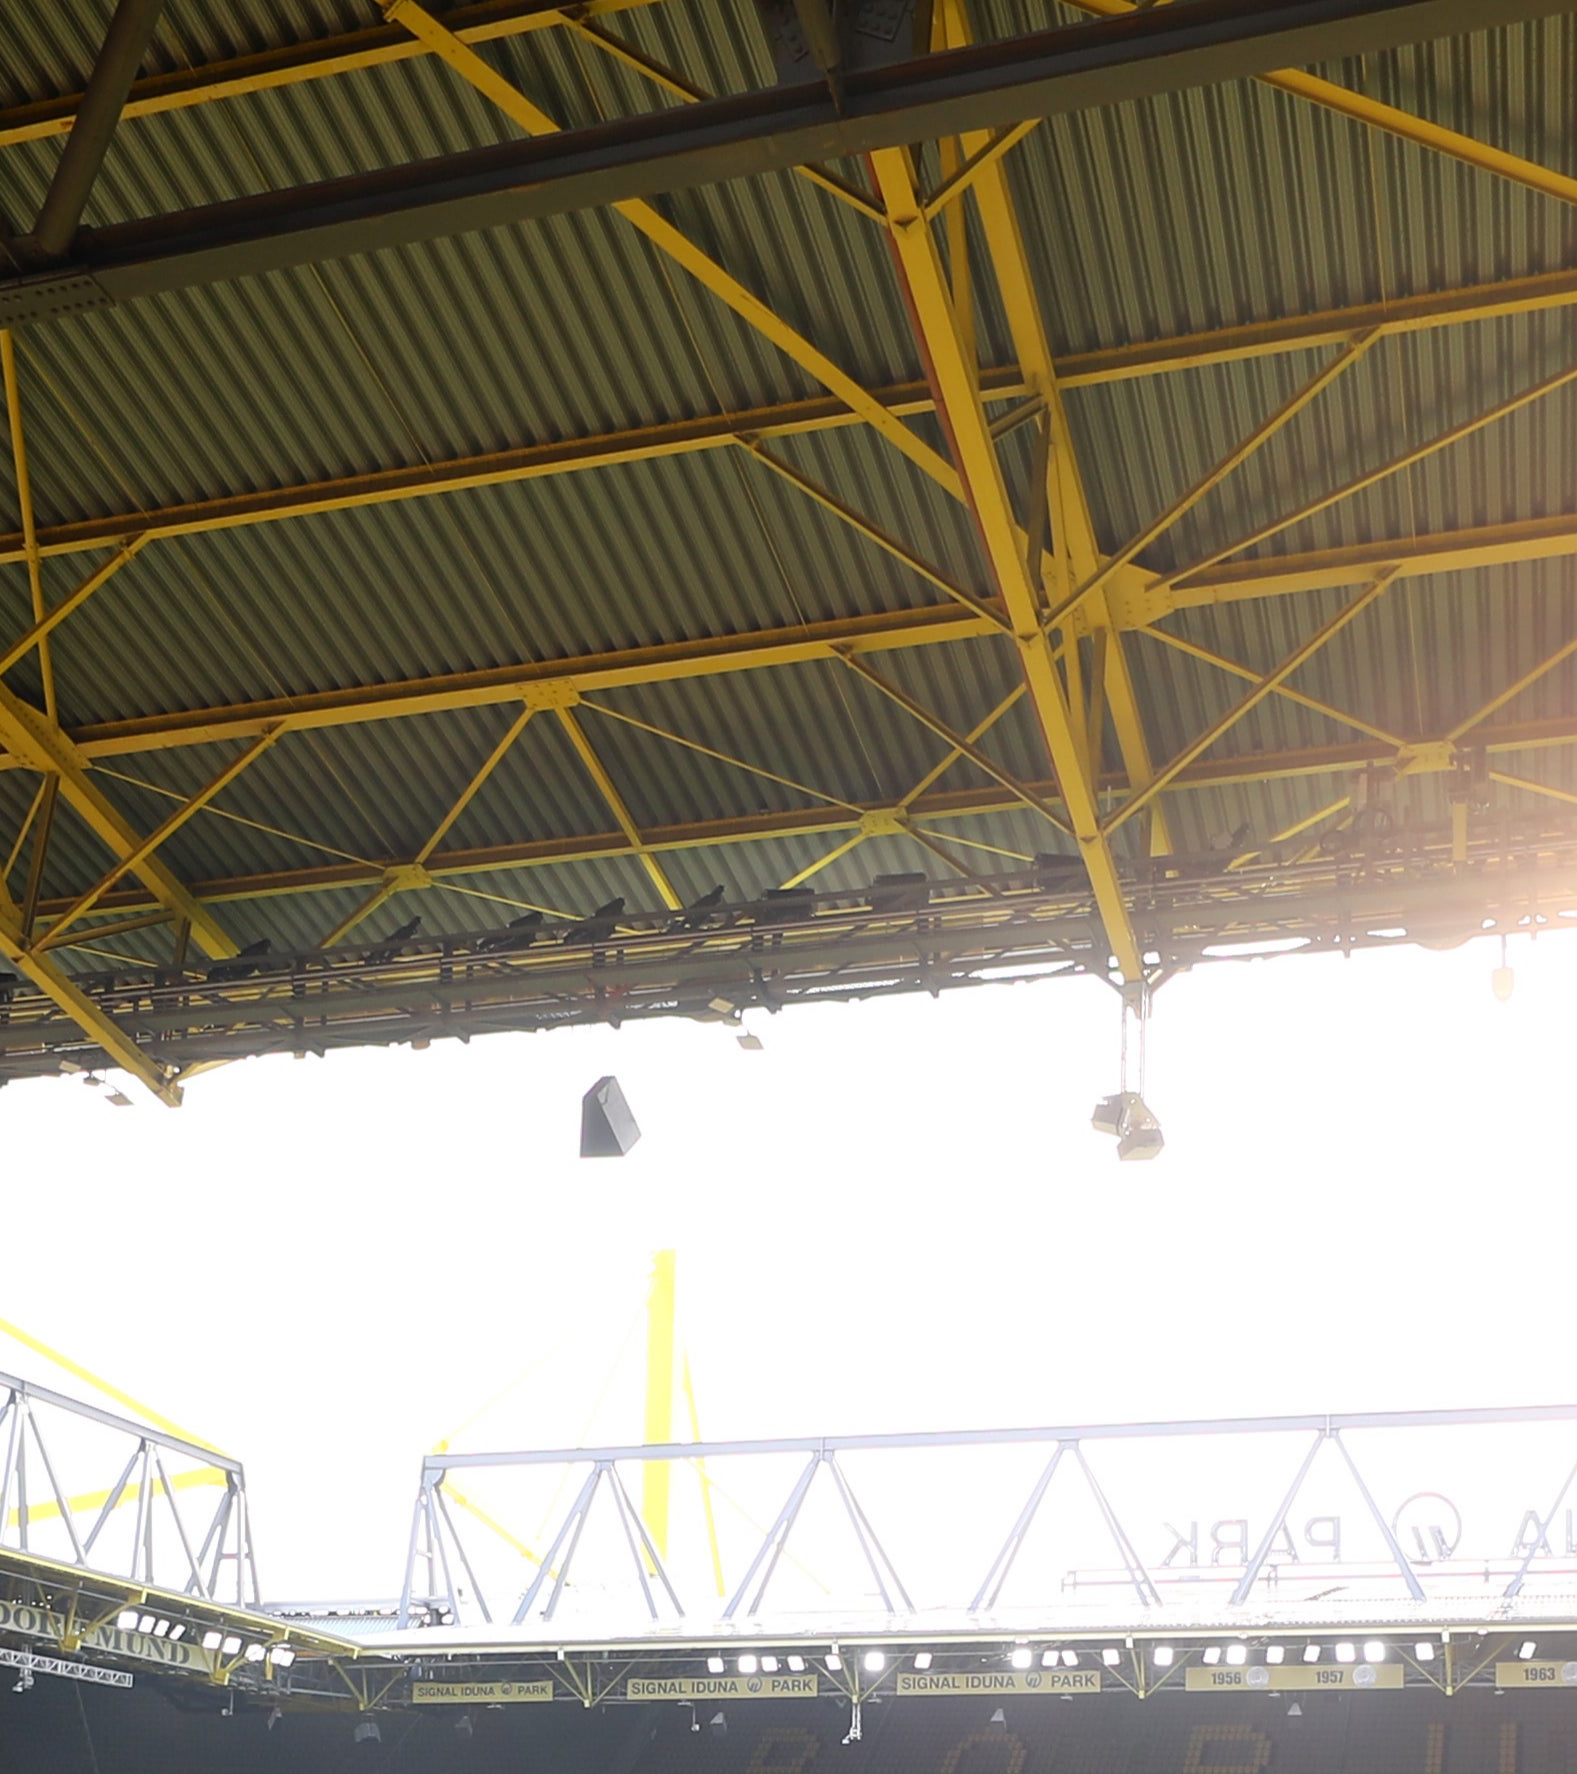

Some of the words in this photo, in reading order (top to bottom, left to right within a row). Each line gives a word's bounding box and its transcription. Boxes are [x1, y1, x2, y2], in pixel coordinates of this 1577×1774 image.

[902, 1676, 961, 1690] SIGNAL
[964, 1675, 1015, 1689] IDUNA
[1050, 1673, 1096, 1688] PARK
[1211, 1671, 1241, 1686] 1956
[1315, 1670, 1345, 1684] 1957
[1523, 1666, 1556, 1682] 1963
[417, 1685, 458, 1698] SIGNAL
[461, 1684, 495, 1697] IDUNA
[518, 1683, 548, 1695] PARK
[631, 1680, 688, 1695] SIGNAL
[692, 1679, 738, 1694] IDUNA
[771, 1678, 813, 1693] PARK
